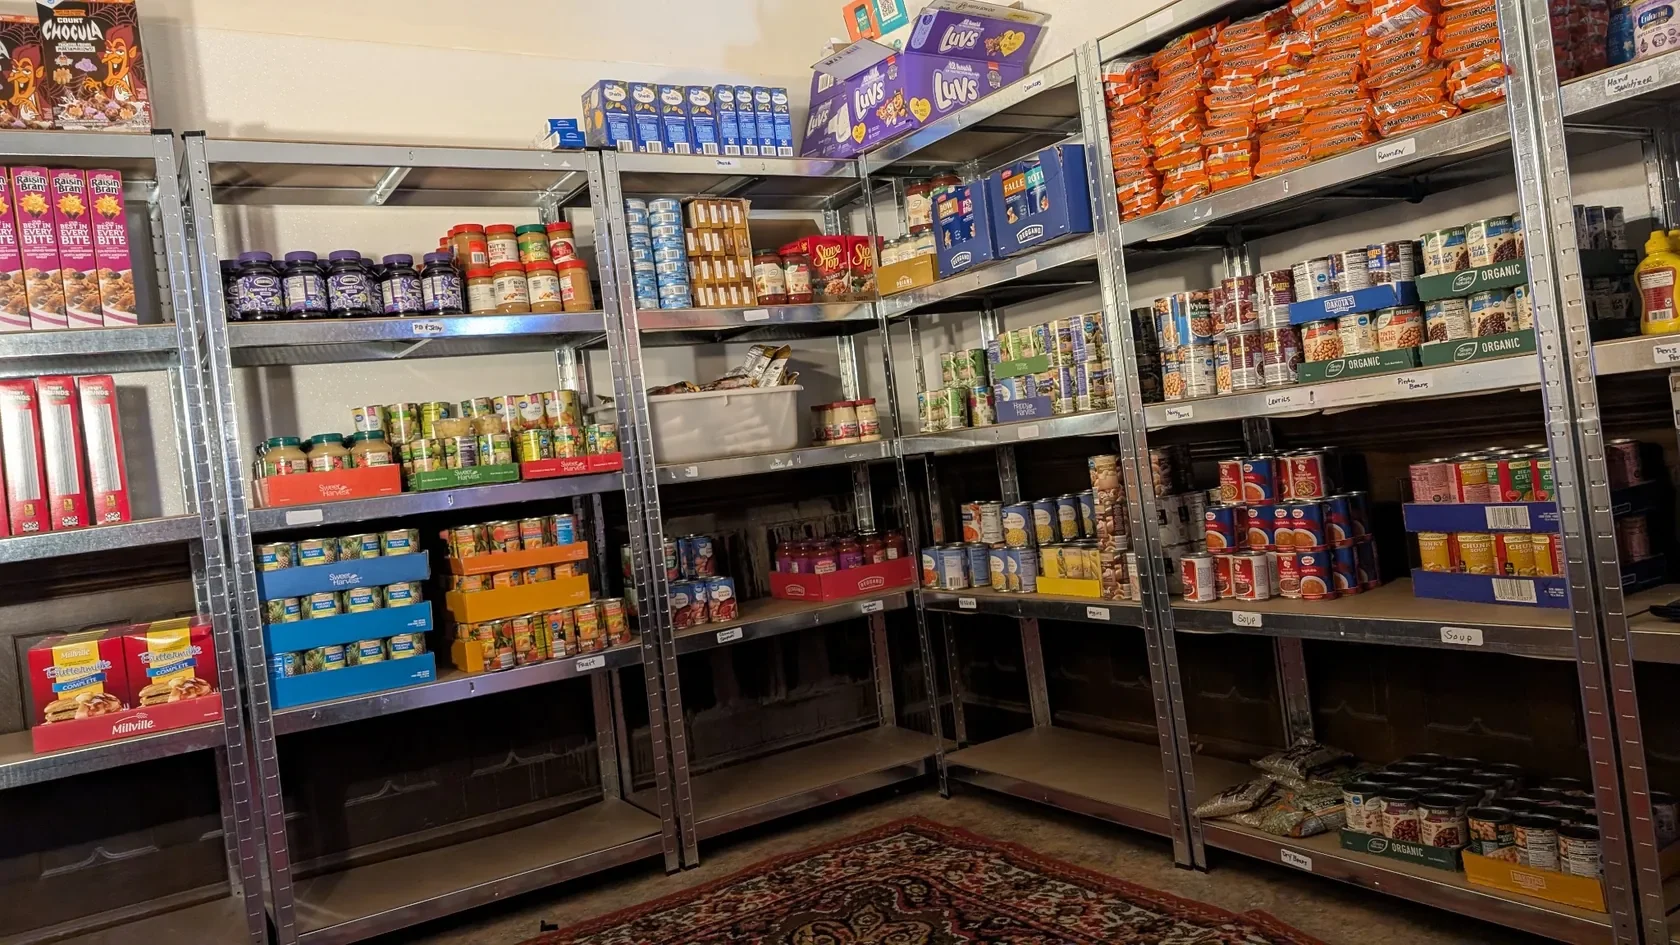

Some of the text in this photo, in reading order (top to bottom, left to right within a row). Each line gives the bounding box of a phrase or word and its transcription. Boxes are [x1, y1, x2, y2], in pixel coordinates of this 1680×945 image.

[42, 19, 104, 41] CHOCULA
[941, 24, 978, 52] Luvs
[1607, 74, 1628, 87] Hand
[934, 72, 979, 111] Luvs
[855, 82, 884, 119] Luvs
[807, 110, 829, 137] Luvs
[1388, 113, 1419, 128] Maruchan
[1378, 147, 1406, 159] RAMEN
[16, 176, 46, 184] Raisin
[54, 177, 83, 186] Raisin
[91, 179, 119, 188] Raisin
[1004, 178, 1024, 193] FALLE
[21, 183, 44, 192] Bran
[58, 185, 81, 193] Bran
[95, 186, 117, 194] Bran
[24, 235, 54, 244] BITE
[61, 236, 90, 245] BITE
[98, 236, 126, 245] BITE
[814, 244, 842, 266] Stove
[852, 244, 871, 266] Sto
[825, 257, 839, 271] Top
[864, 257, 872, 270] To
[1481, 264, 1521, 281] ORGANIC
[1325, 297, 1354, 310] DAKOTA'S
[1474, 294, 1491, 303] ORGANIC
[1481, 337, 1520, 353] ORGANIC
[1348, 356, 1380, 369] ORGANIC
[1398, 377, 1415, 385] Pinto
[1013, 402, 1029, 412] Happy
[1016, 408, 1036, 416] Harvest
[333, 577, 359, 586] Harvest
[1237, 614, 1256, 625] SOUP
[1443, 629, 1472, 642] Soup
[61, 648, 90, 659] Millville
[155, 662, 188, 676] COMPLETE
[62, 677, 98, 691] COMPLETE
[111, 718, 154, 736] Millville
[1392, 843, 1424, 857] ORGANIC
